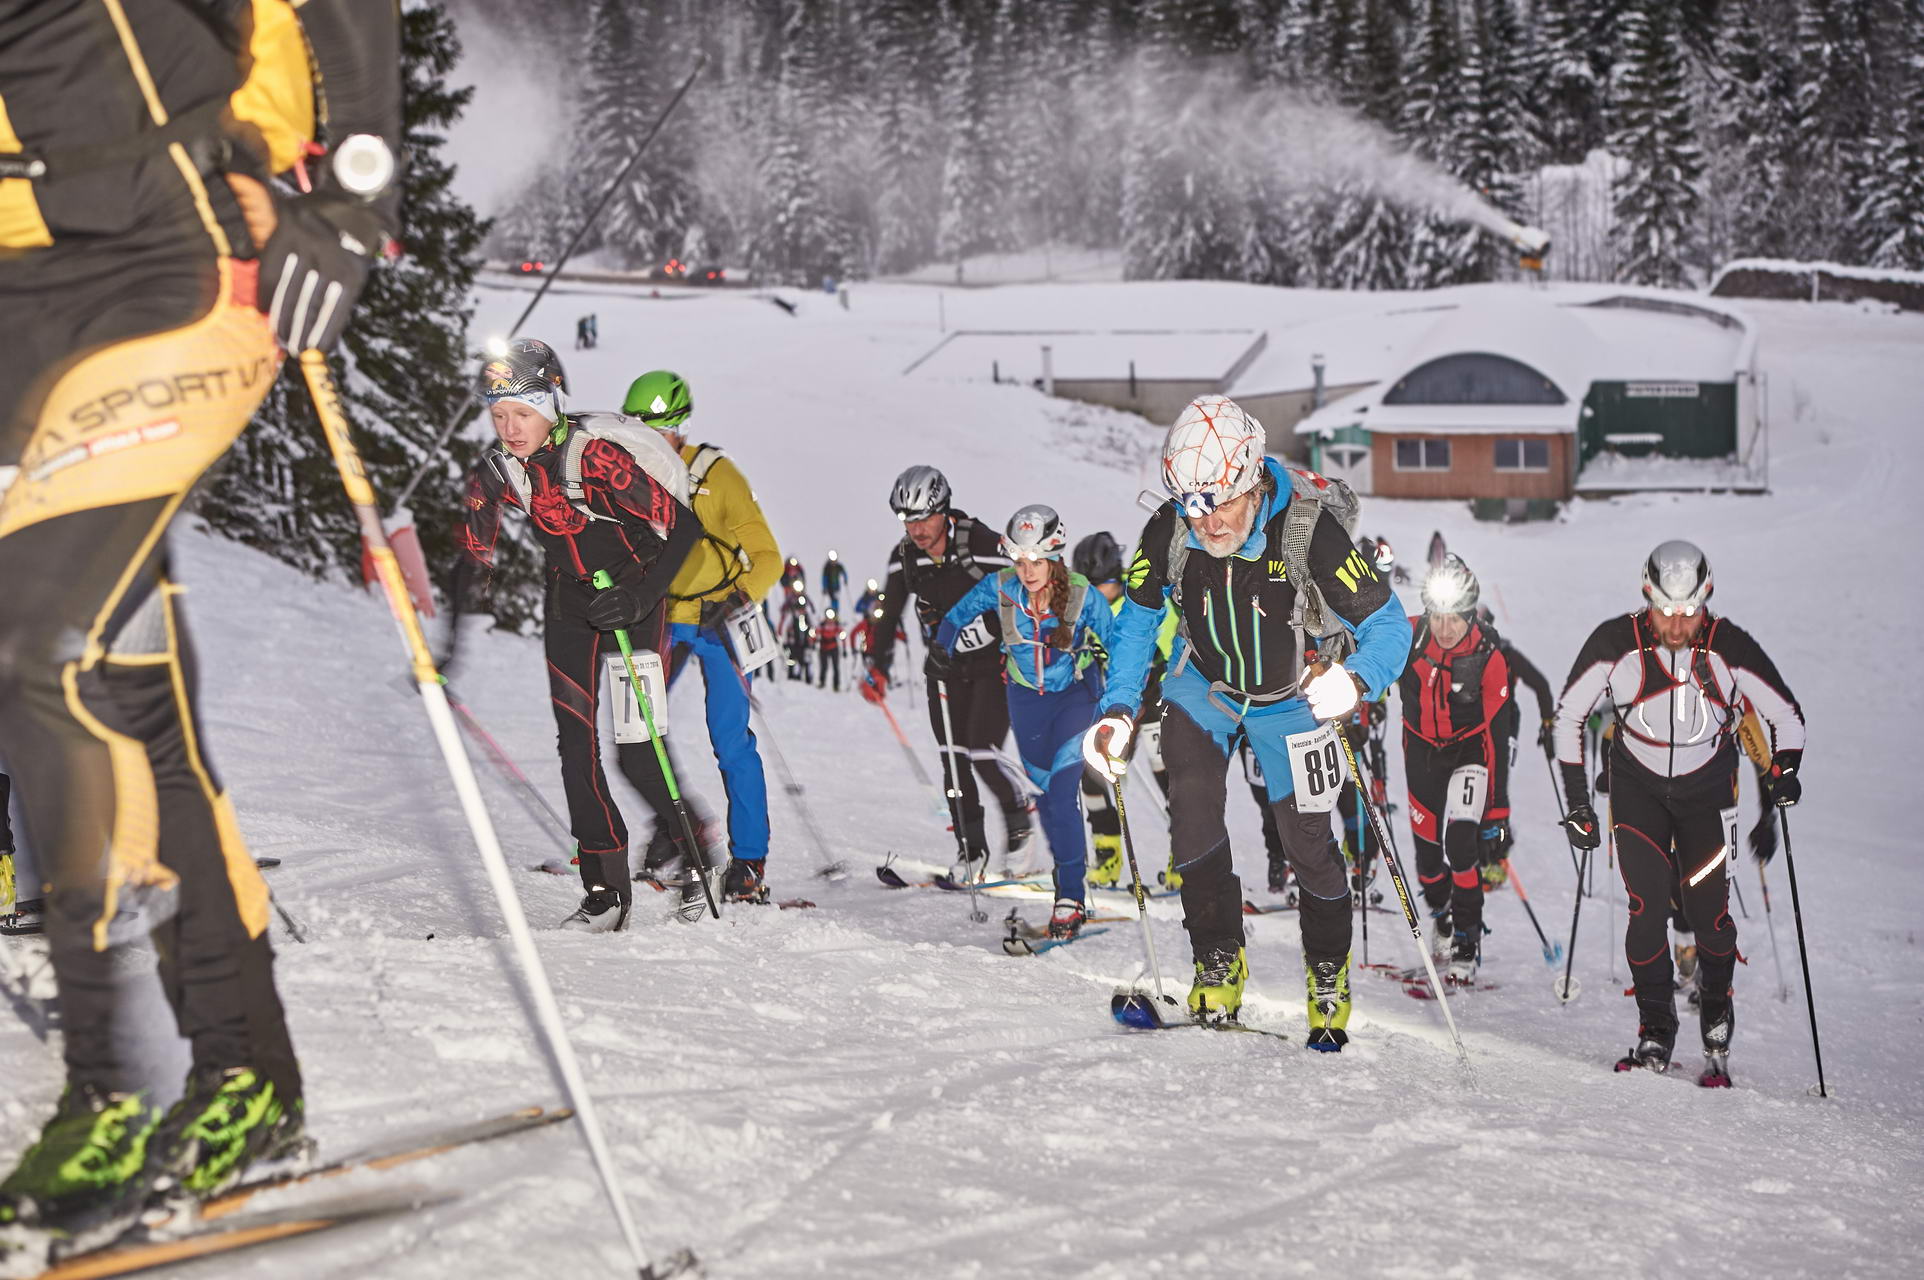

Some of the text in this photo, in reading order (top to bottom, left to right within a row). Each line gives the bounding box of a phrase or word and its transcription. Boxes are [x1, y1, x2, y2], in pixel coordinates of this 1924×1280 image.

[738, 613, 764, 655] 87
[960, 628, 983, 648] 67
[1304, 740, 1341, 797] 89
[1463, 776, 1475, 806] 5
